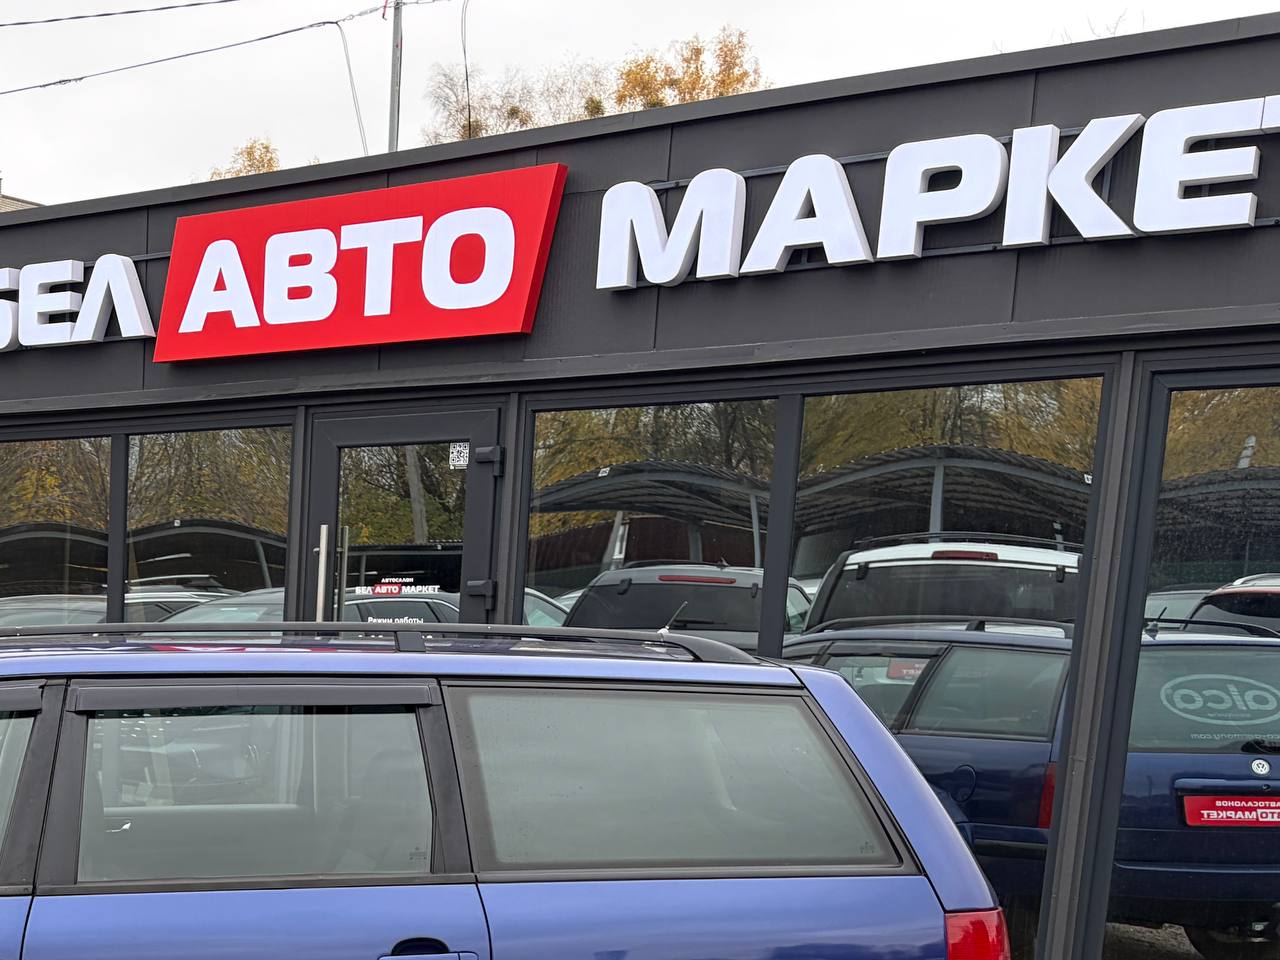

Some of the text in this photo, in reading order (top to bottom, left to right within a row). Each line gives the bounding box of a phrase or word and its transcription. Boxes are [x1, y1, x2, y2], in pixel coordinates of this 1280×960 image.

[178, 206, 515, 333] АВТО
[355, 585, 440, 595] БЕЛ АВТО МАРКЕТ
